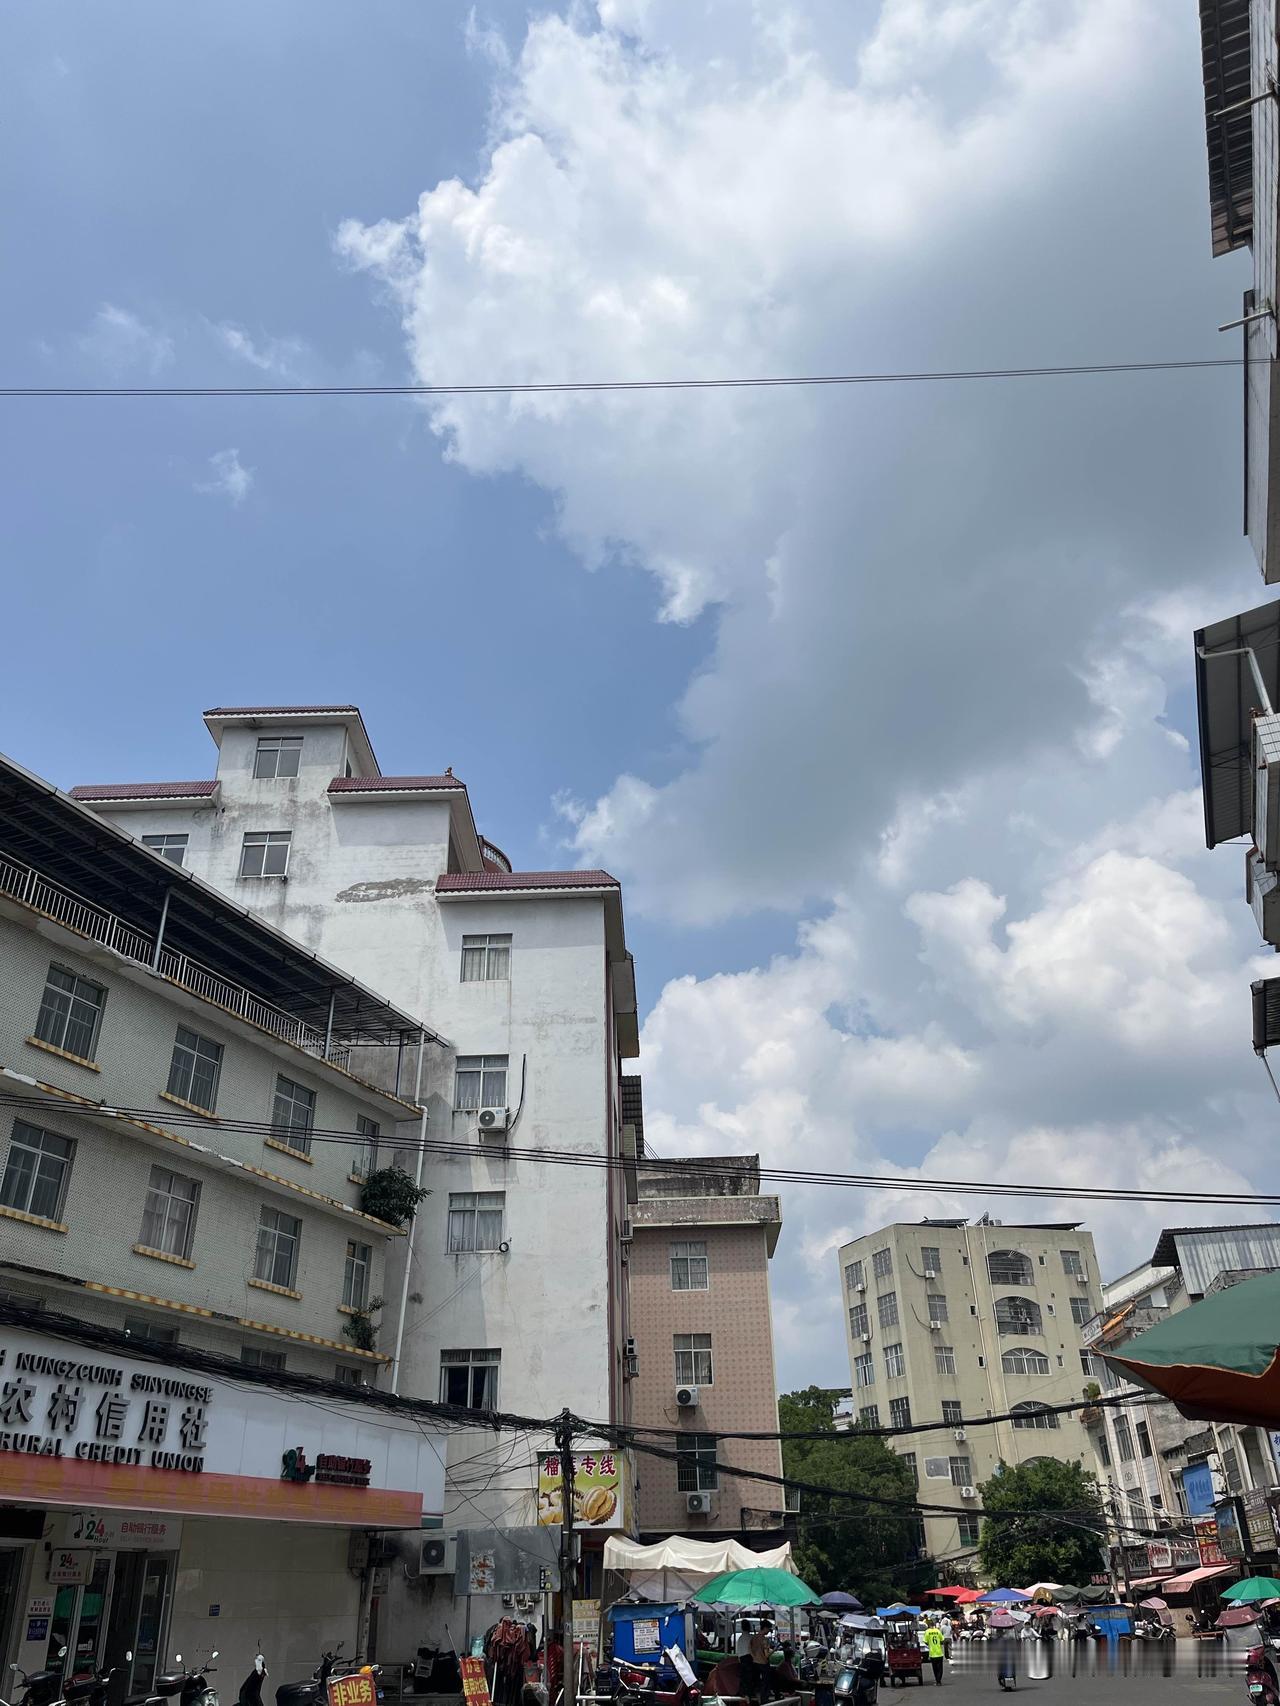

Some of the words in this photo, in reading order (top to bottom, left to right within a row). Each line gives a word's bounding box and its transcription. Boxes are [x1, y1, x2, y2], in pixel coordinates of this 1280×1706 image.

[0, 1377, 209, 1449] 农村信用社
[0, 1431, 65, 1457] RURAL
[75, 1441, 145, 1465] CREDIT
[151, 1450, 204, 1473] UNION
[85, 1518, 105, 1540] 24
[59, 1553, 73, 1568] 24
[932, 1635, 938, 1645] 6
[332, 1680, 372, 1706] 非业务
